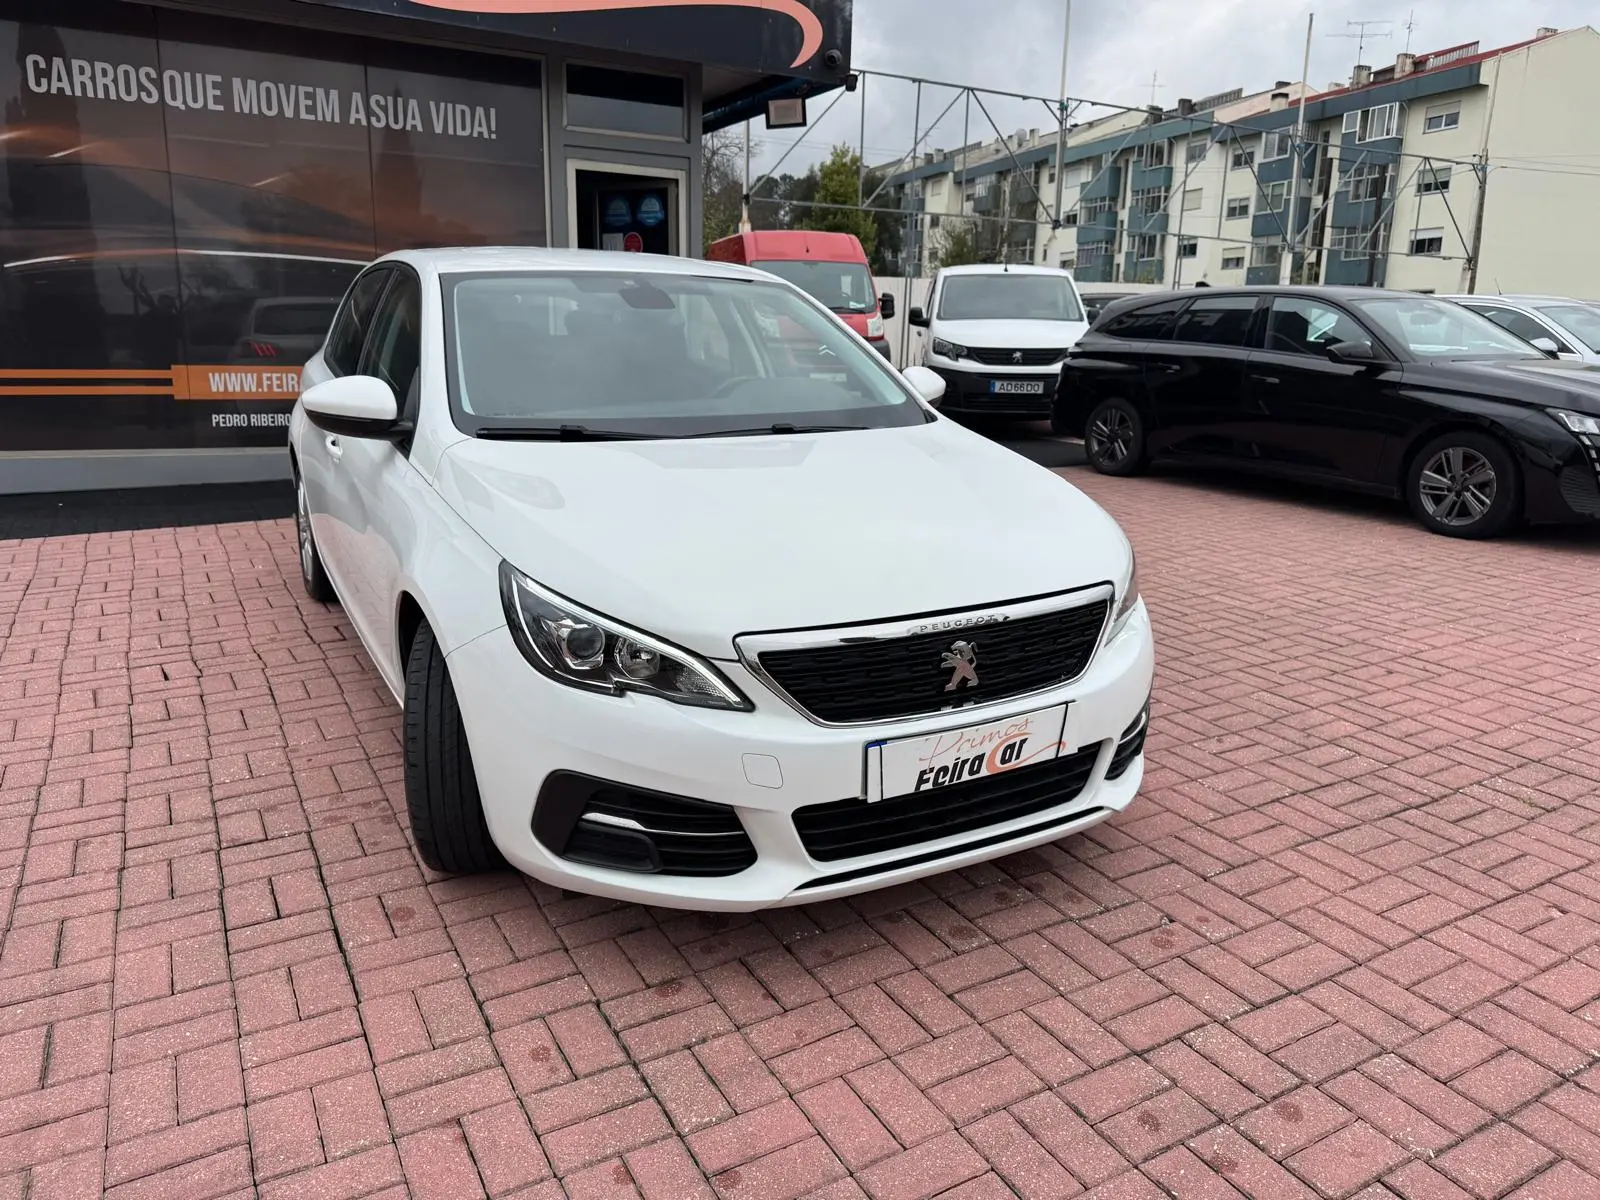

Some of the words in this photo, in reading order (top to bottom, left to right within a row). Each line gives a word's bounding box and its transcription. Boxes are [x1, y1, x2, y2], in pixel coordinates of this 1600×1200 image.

[25, 53, 160, 104] CARROS
[163, 69, 225, 111] QUE
[231, 77, 341, 123] MOVEM
[349, 91, 368, 126] A
[369, 94, 423, 132] SUA
[429, 100, 498, 140] VIDA!
[208, 372, 301, 393] WWW.FEIR
[212, 413, 248, 427] PEDRO
[919, 614, 996, 633] PEUGEOT
[918, 717, 1034, 772] Primos
